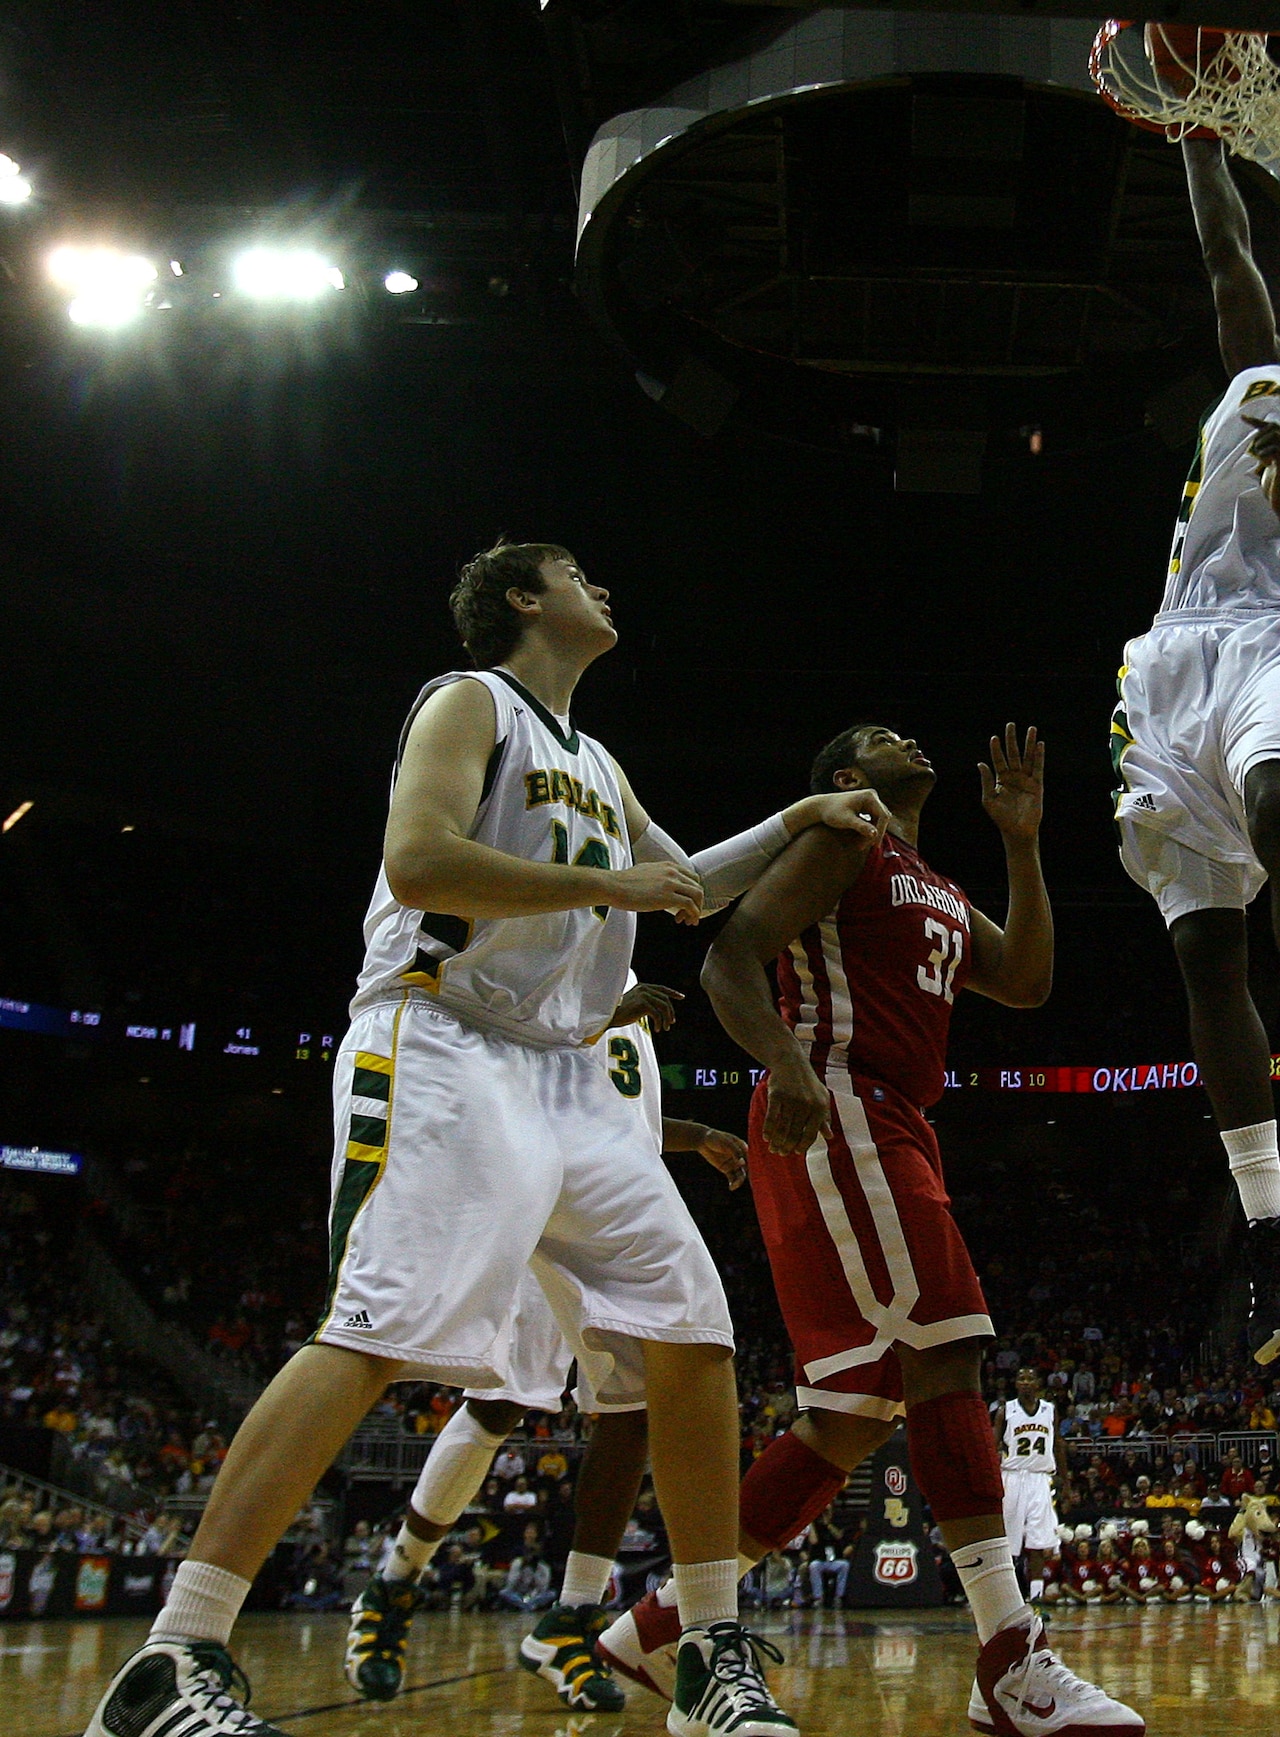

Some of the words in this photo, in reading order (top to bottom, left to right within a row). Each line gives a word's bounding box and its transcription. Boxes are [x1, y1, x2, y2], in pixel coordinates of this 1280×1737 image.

[891, 873, 971, 933] OKLAHOM
[917, 917, 963, 1006] 31
[235, 1027, 251, 1040] 41
[299, 1033, 311, 1045] P
[321, 1035, 333, 1048] R
[607, 1035, 643, 1099] 3
[1092, 1061, 1203, 1092] OKLAHO
[695, 1068, 718, 1087] FLS
[721, 1070, 740, 1085] 10
[969, 1072, 979, 1087] 2
[1000, 1070, 1022, 1088] FLS
[1028, 1073, 1046, 1087] 10
[1016, 1436, 1046, 1456] 24
[881, 1559, 910, 1578] 66
